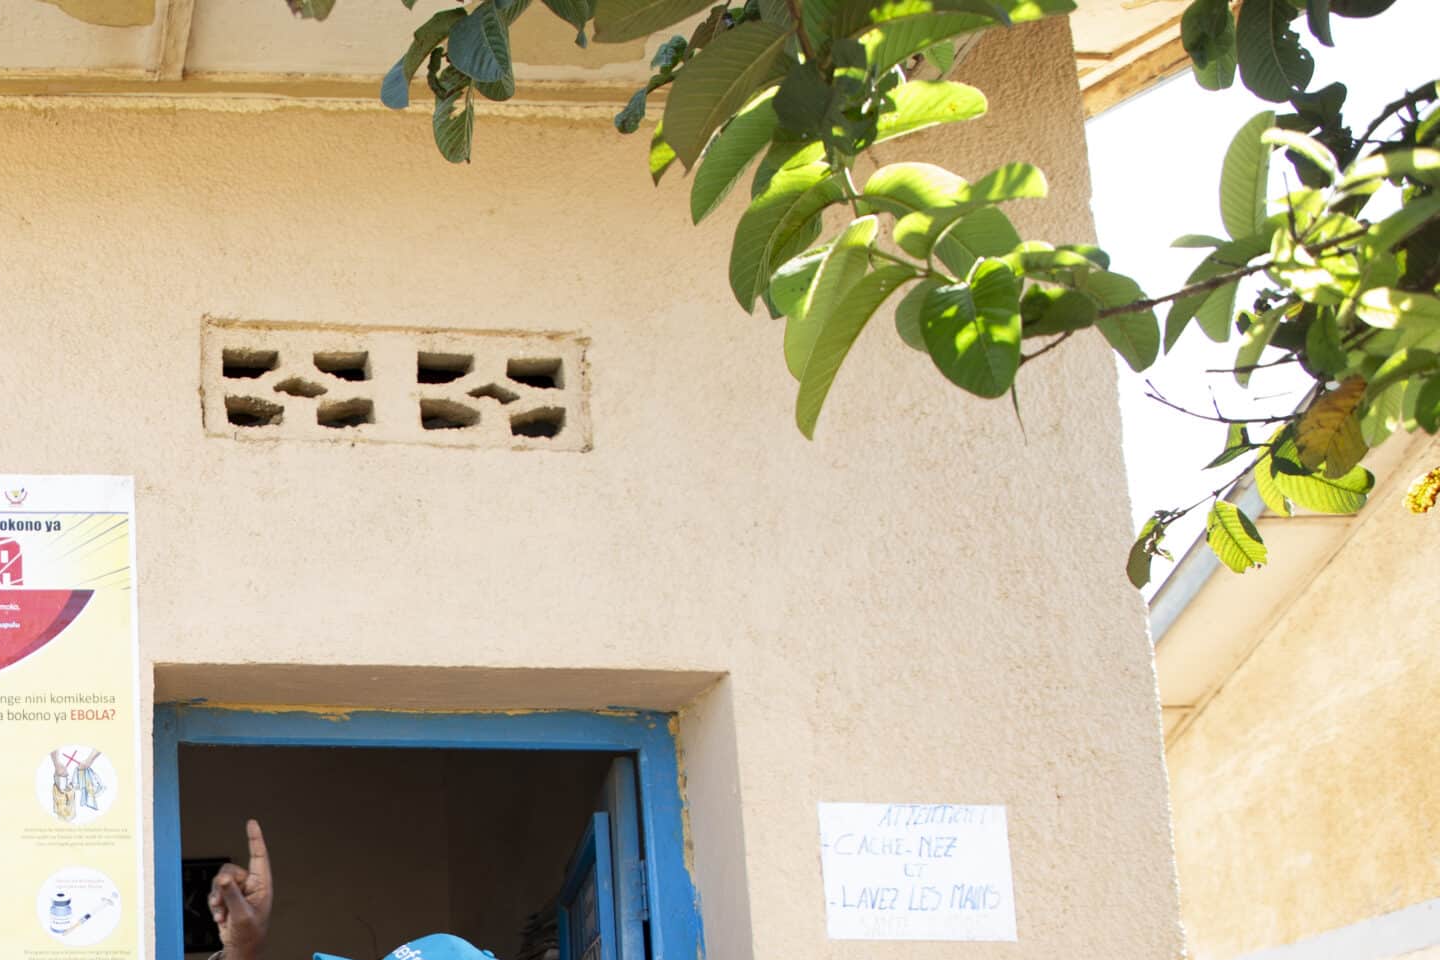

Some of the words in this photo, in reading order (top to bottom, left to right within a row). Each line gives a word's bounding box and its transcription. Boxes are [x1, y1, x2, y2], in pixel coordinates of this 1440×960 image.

[45, 521, 61, 533] ya
[24, 694, 47, 704] nini
[49, 693, 116, 704] komikebisa
[7, 709, 51, 721] bokono
[53, 711, 67, 724] ya
[70, 709, 116, 721] EBOLA?
[907, 886, 942, 911] LES
[949, 883, 1001, 910] MAINS
